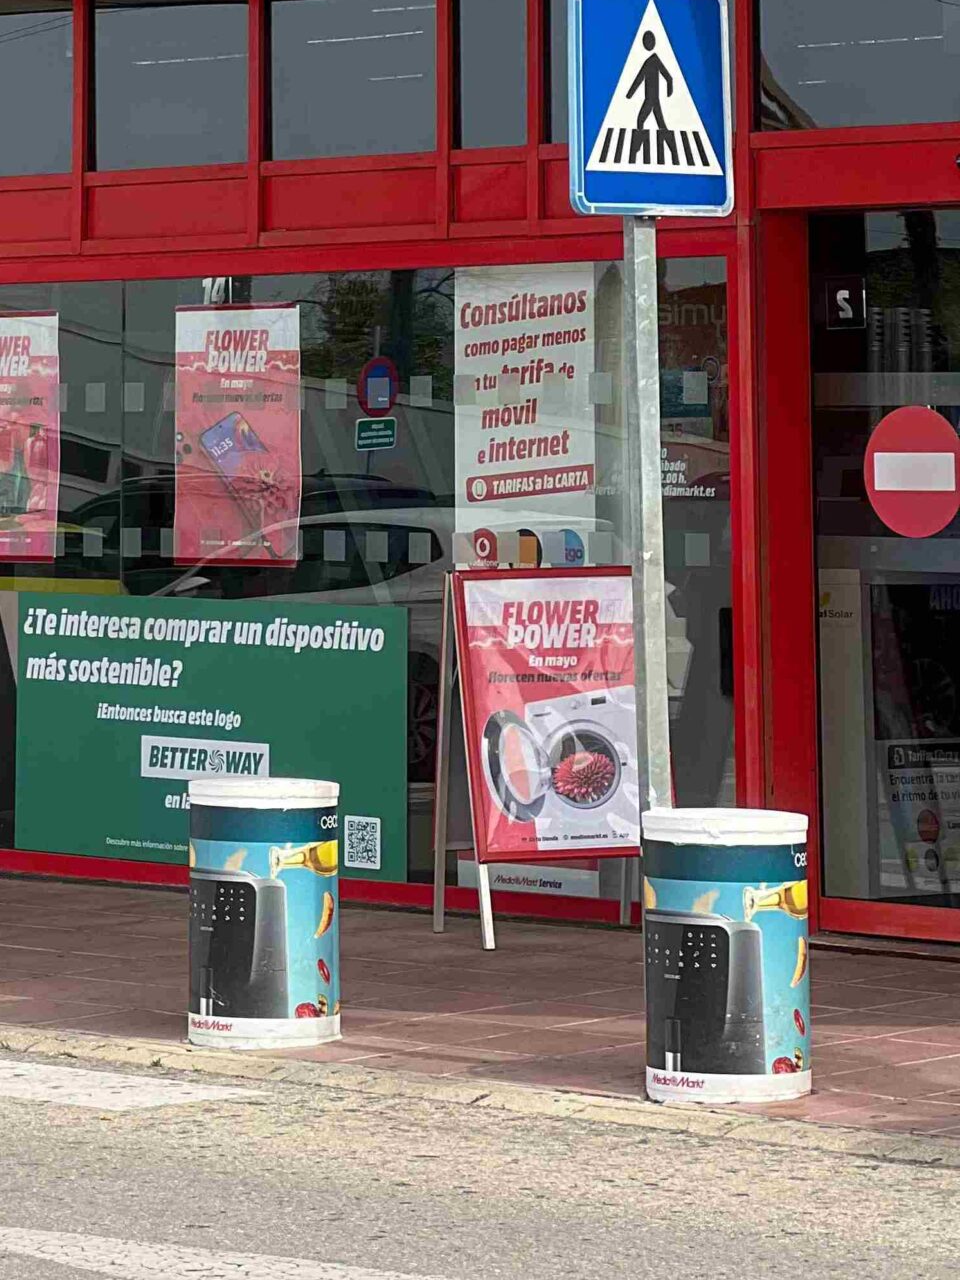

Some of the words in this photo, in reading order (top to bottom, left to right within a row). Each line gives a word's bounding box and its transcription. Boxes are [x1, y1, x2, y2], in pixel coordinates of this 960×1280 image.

[202, 277, 226, 305] 14
[460, 290, 587, 329] Consúltanos
[205, 329, 270, 352] FLOWER
[464, 340, 500, 357] como
[501, 333, 540, 356] pagar
[542, 328, 586, 347] menos
[207, 350, 268, 372] POWER
[483, 374, 497, 390] tu
[481, 398, 538, 430] móvil
[477, 450, 486, 464] e
[489, 430, 570, 463] internet
[492, 477, 534, 495] TARIFAS
[535, 479, 542, 490] a
[544, 475, 553, 490] la
[555, 471, 589, 488] CARTA
[662, 485, 716, 497] diamarkt.es
[502, 600, 600, 625] FLOWER
[24, 608, 56, 636] ¿Te
[59, 608, 140, 640] interesa
[144, 618, 232, 647] comprar
[235, 621, 261, 645] un
[265, 618, 384, 653] dispositivo
[506, 622, 597, 649] POWER
[26, 652, 65, 680] más
[69, 656, 183, 687] sostenible?
[528, 655, 543, 667] En
[544, 656, 578, 668] mayo
[97, 703, 152, 721] ¡Entonces
[153, 706, 186, 724] busca
[188, 710, 214, 726] este
[214, 709, 242, 730] logo
[148, 745, 208, 772] BETTER
[225, 751, 264, 775] WAY
[165, 794, 180, 809] en
[538, 878, 562, 889] Service
